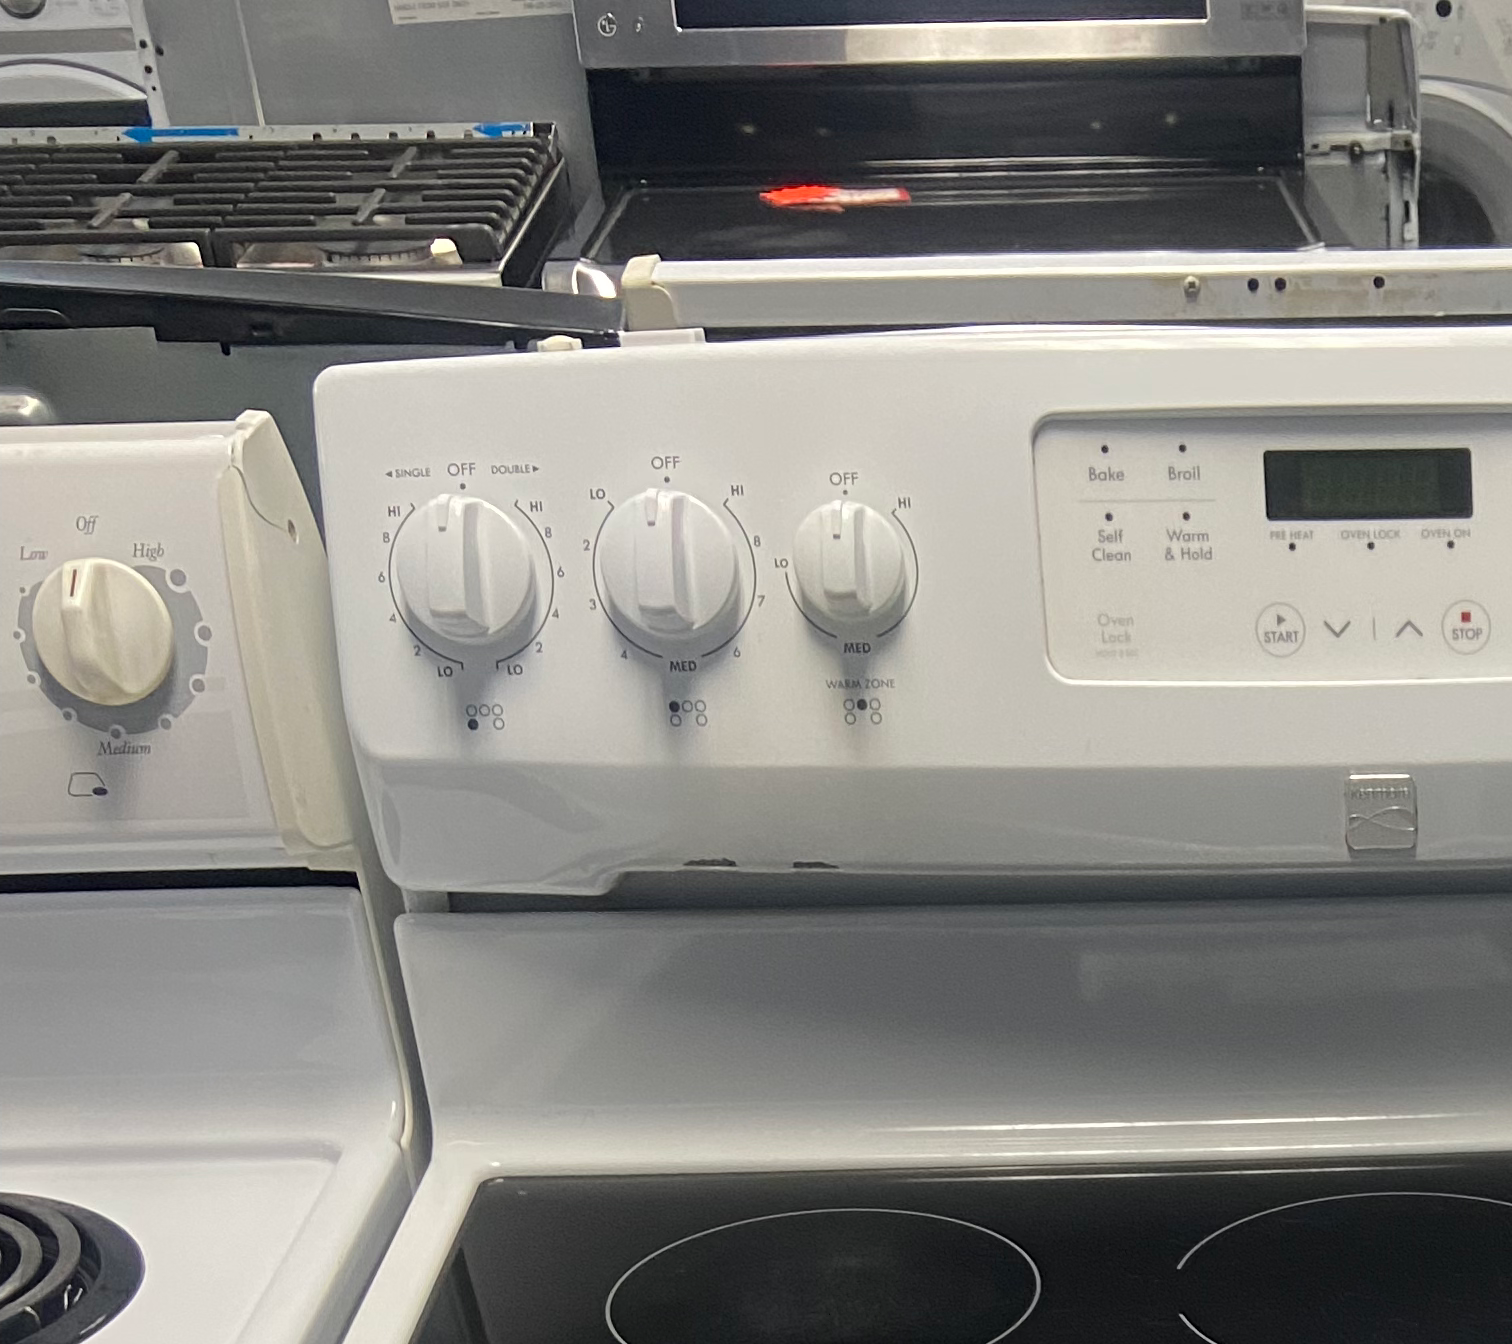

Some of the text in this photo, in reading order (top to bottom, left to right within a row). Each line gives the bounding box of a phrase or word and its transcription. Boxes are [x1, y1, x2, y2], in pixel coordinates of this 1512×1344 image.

[651, 456, 682, 470] OFF
[395, 463, 530, 478] SINGLE OFF DOUBLE
[1088, 466, 1125, 482] Bake
[1168, 465, 1201, 481] Broil
[829, 472, 859, 486] OFF
[590, 488, 606, 500] LO
[730, 484, 744, 497] HI
[530, 501, 543, 513] HI
[898, 497, 911, 509] HI
[388, 506, 401, 518] HI
[76, 515, 99, 535] Off
[382, 532, 391, 544] 8
[544, 527, 552, 539] 8
[1097, 529, 1123, 543] Self
[1166, 528, 1210, 542] Warm
[1269, 530, 1314, 541] PRE HEAT
[1341, 529, 1401, 540] OVEN LOCK
[1421, 528, 1471, 539] OVEN ON
[583, 539, 591, 551] 2
[753, 535, 761, 547] 8
[20, 546, 48, 561] Low
[132, 542, 165, 561] High
[1092, 547, 1132, 562] Clean
[1164, 547, 1213, 561] & Hold
[774, 558, 789, 569] LO
[378, 571, 386, 583] 6
[557, 566, 565, 578] 6
[589, 599, 597, 610] 3
[757, 595, 766, 607] 7
[389, 613, 397, 623] 4
[552, 608, 560, 619] 4
[1097, 613, 1135, 627] Oven
[1264, 630, 1299, 644] START
[1452, 628, 1483, 641] STOP
[413, 645, 421, 656] 2
[535, 642, 543, 653] 2
[733, 646, 741, 658] 6
[843, 642, 871, 654] MED
[620, 649, 628, 660] 4
[437, 666, 454, 678] LO
[507, 664, 523, 676] LO
[669, 660, 697, 672] MED
[825, 678, 896, 689] WARM ZONE
[97, 741, 152, 756] Medium
